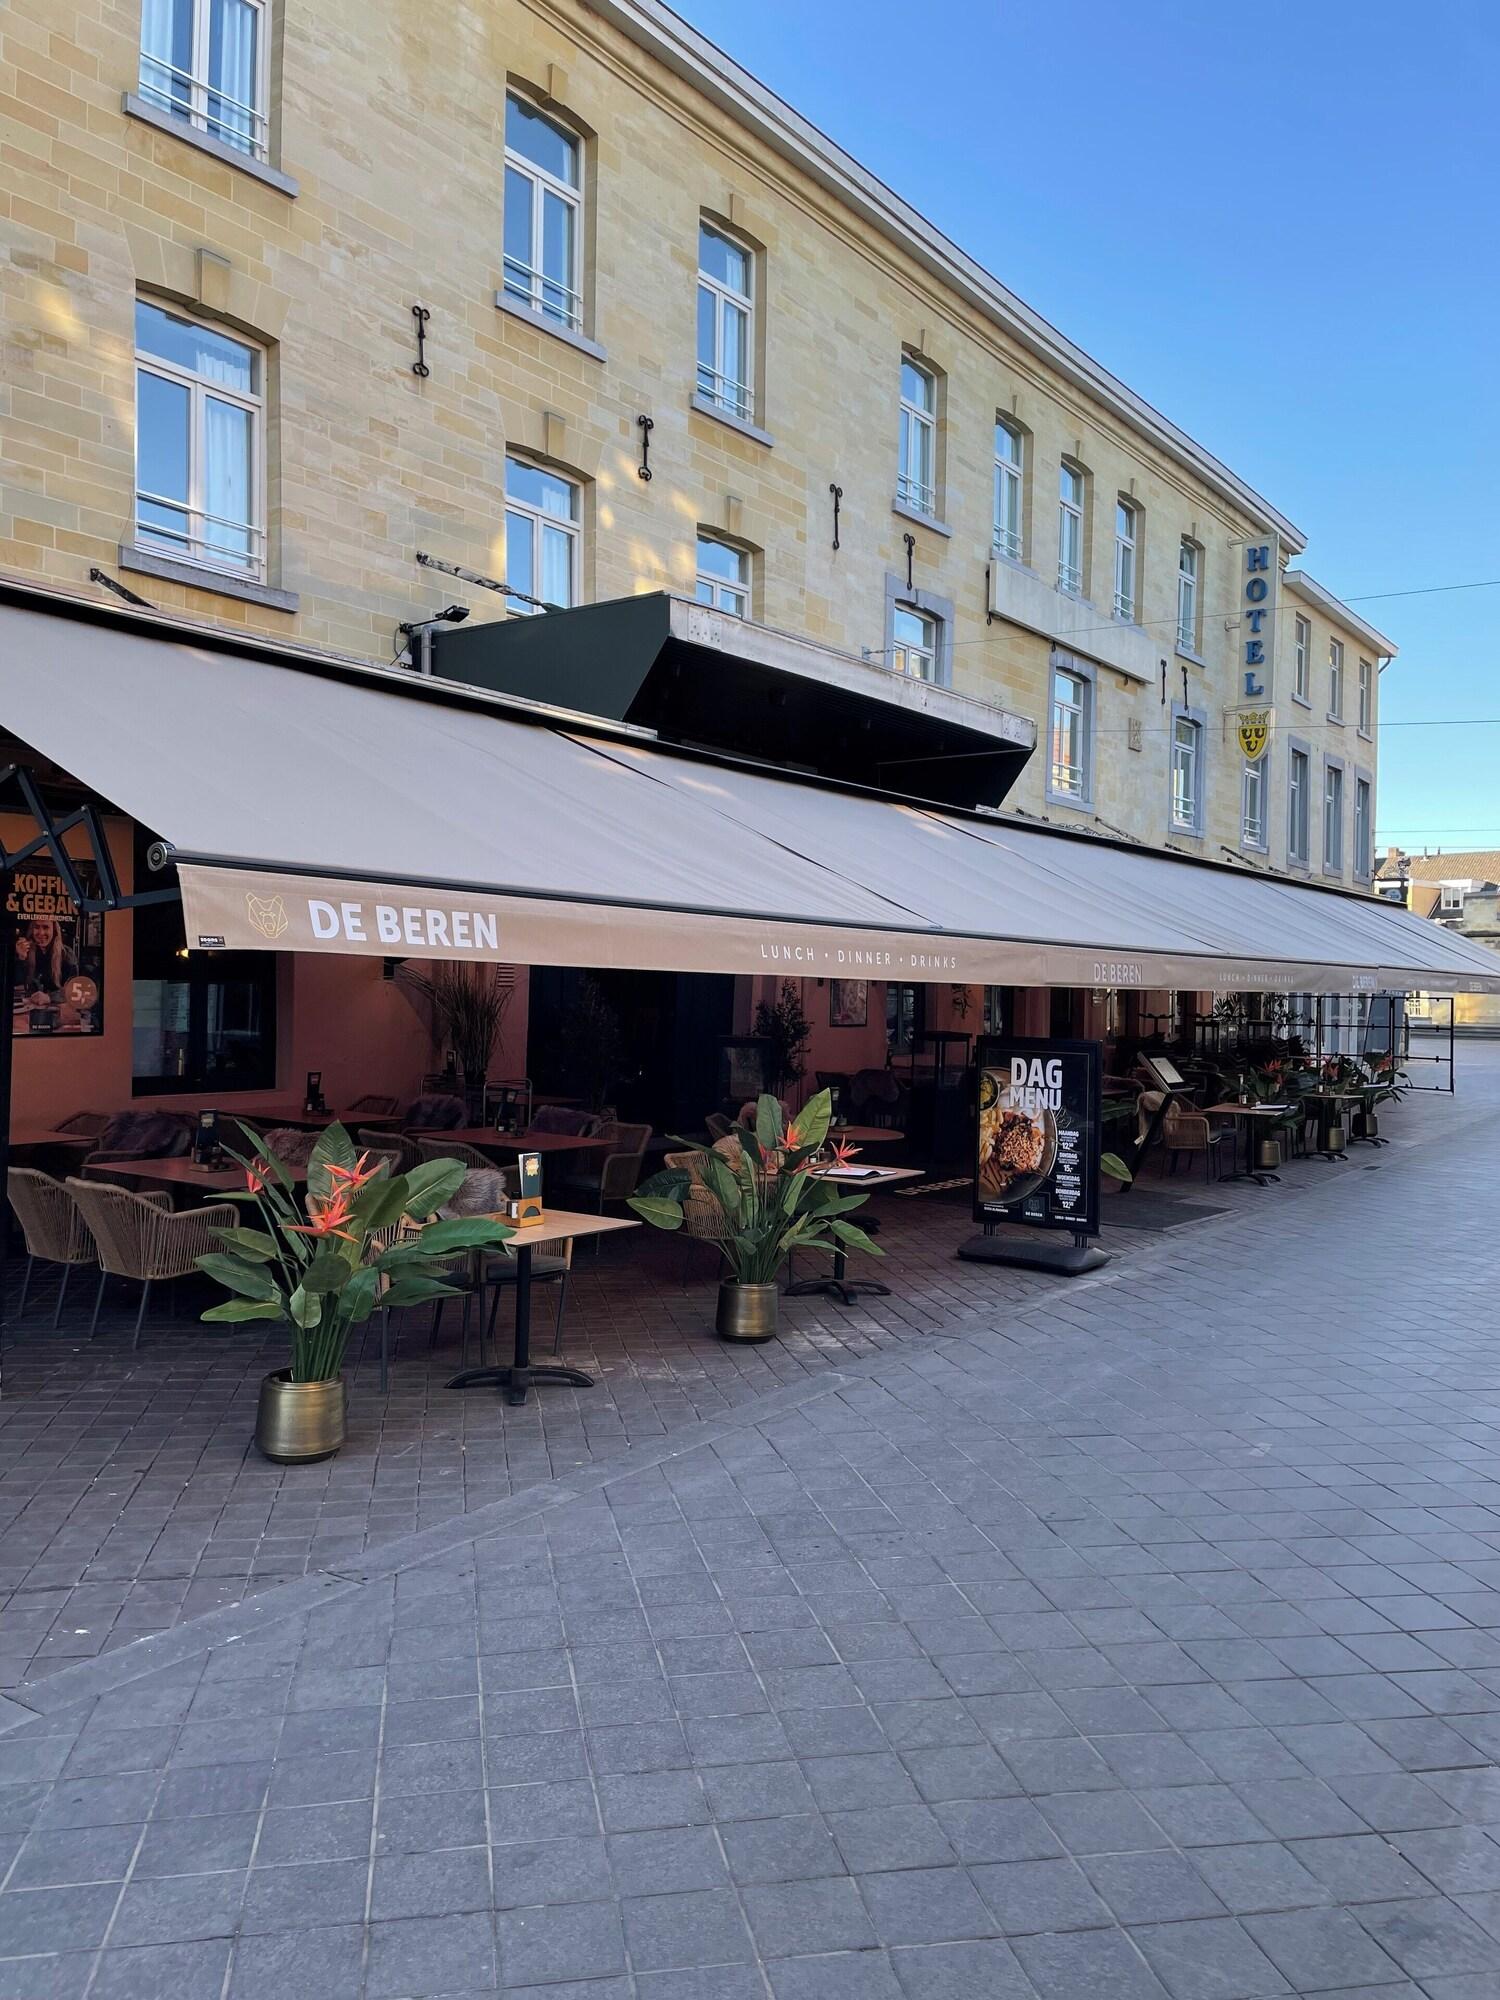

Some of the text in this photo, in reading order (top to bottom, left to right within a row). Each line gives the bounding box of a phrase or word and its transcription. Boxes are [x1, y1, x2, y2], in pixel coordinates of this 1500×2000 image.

[1244, 546, 1269, 696] HOTEL
[23, 894, 79, 915] GEBAK
[308, 899, 499, 949] DE BEREN
[760, 944, 957, 969] LUNCH DINNER DRINKS
[1094, 963, 1143, 984] DE BEREN
[1011, 1057, 1063, 1089] DAG
[1008, 1086, 1063, 1111] MENU
